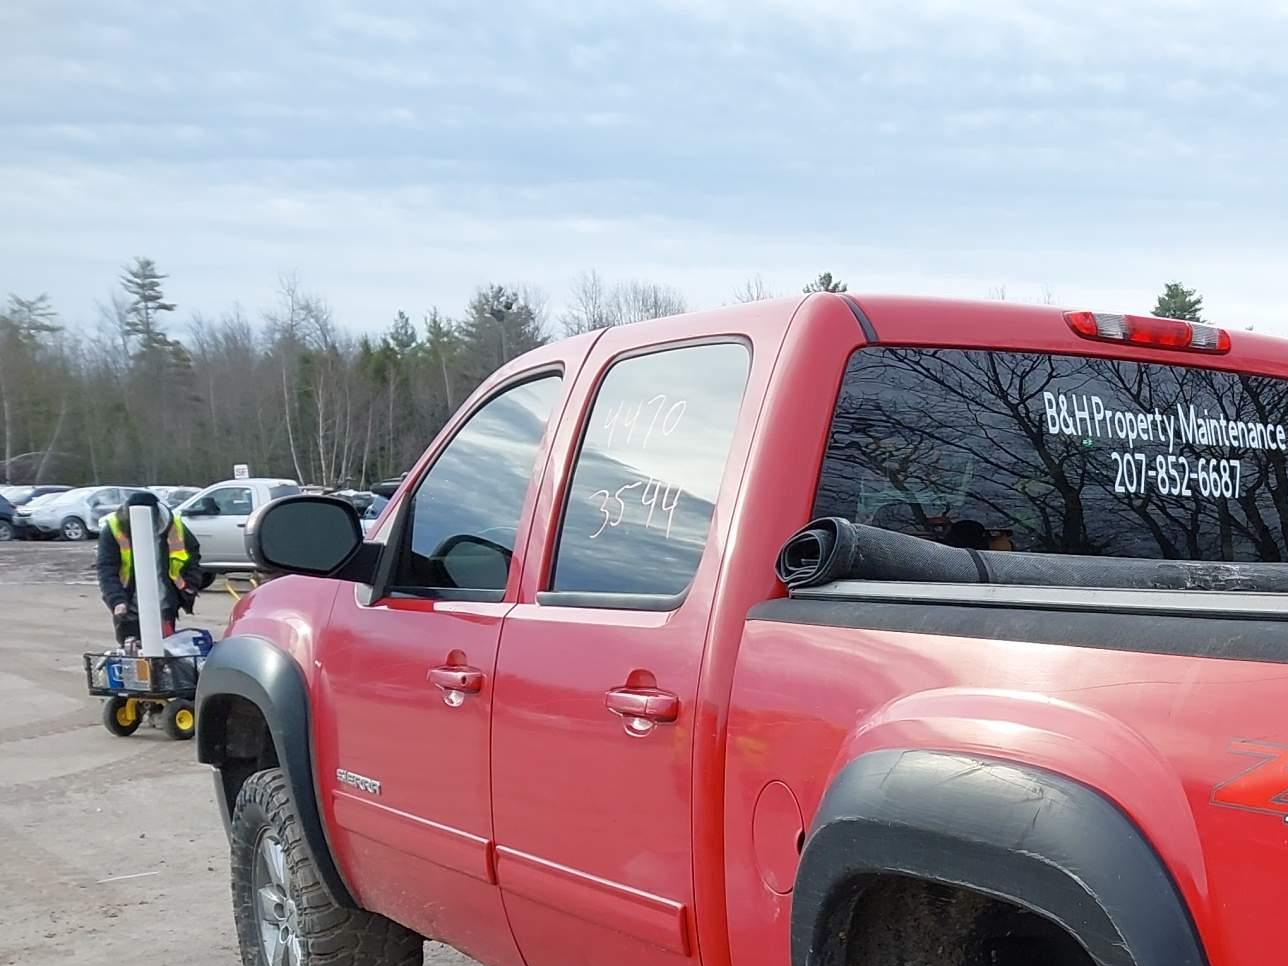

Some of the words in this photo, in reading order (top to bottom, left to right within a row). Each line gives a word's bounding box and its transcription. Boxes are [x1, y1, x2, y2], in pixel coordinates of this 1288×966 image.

[1043, 391, 1092, 436] B&H
[1091, 396, 1175, 454] Property
[1177, 403, 1287, 450] Maintenance
[1111, 451, 1241, 499] 207-852-6687
[588, 475, 683, 538] 3544
[336, 768, 381, 795] SIERRA
